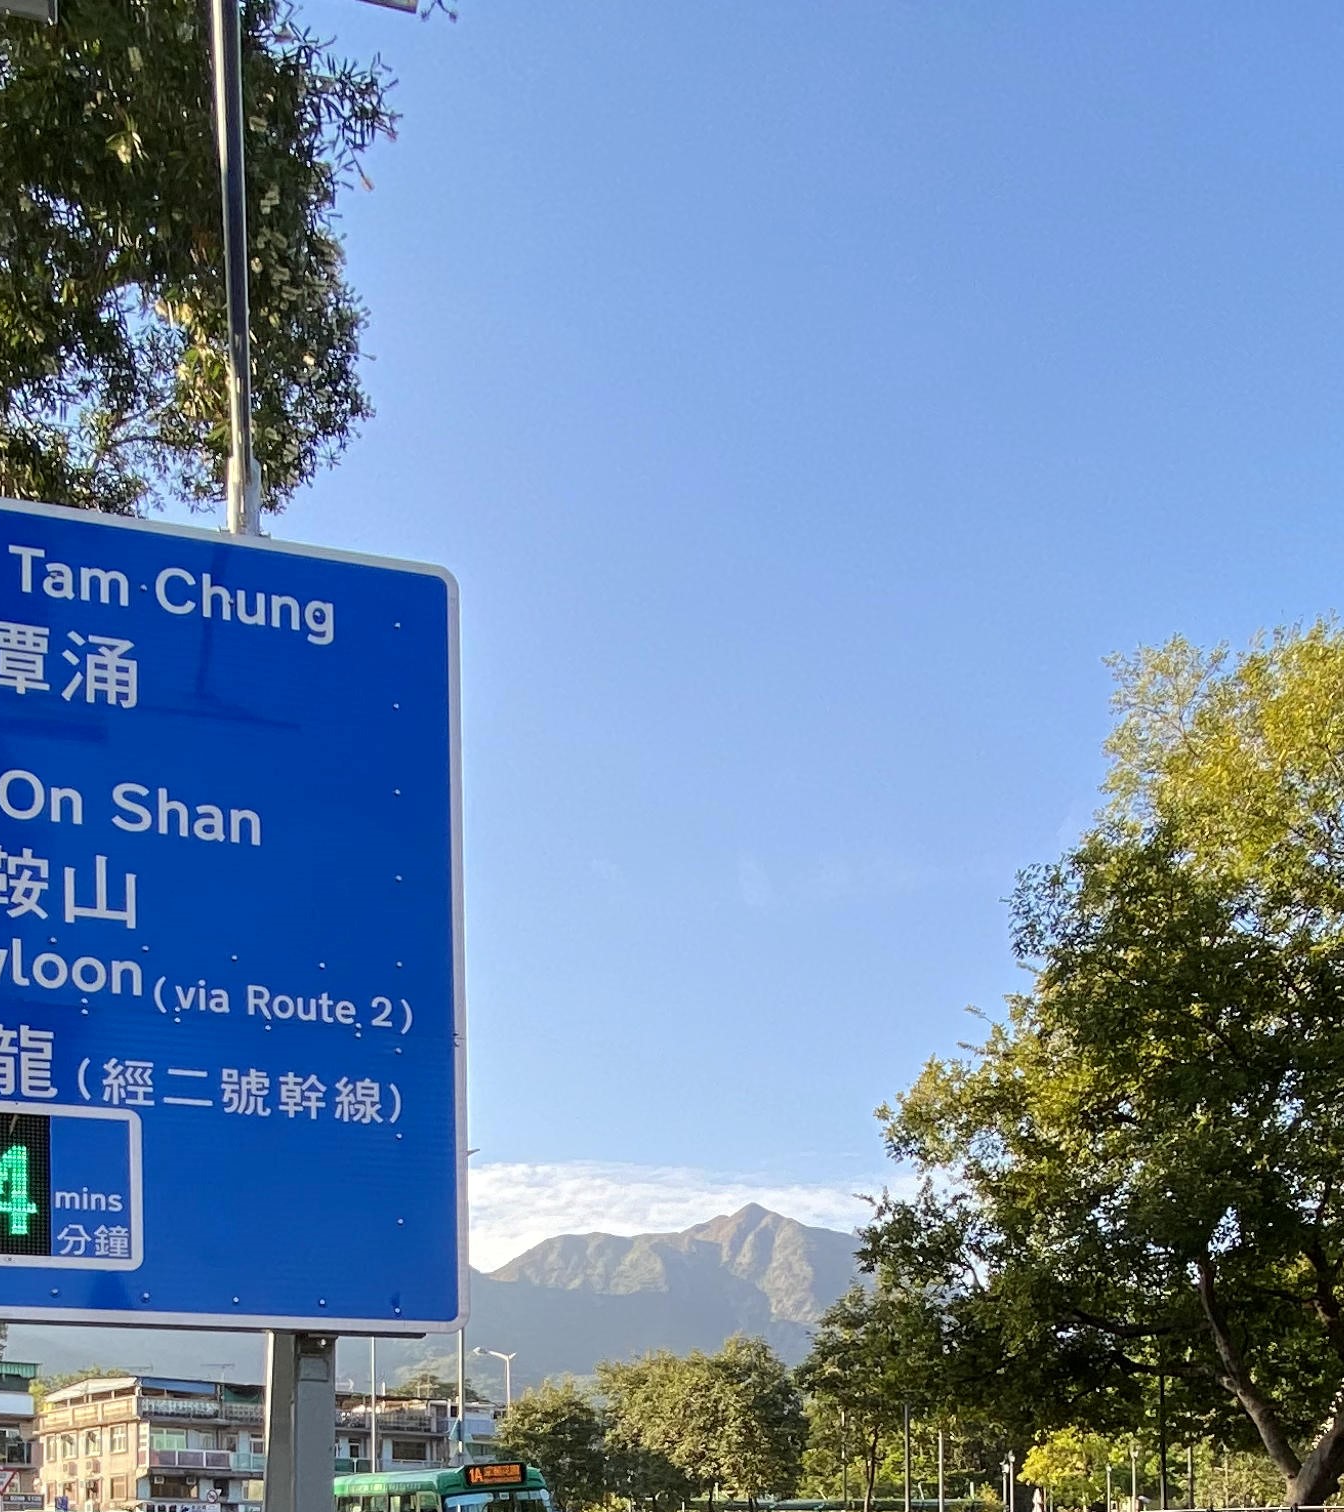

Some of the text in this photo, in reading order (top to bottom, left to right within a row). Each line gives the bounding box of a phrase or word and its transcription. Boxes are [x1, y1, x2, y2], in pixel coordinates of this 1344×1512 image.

[8, 544, 129, 607] Tam
[155, 567, 335, 645] Chung
[112, 782, 262, 847] Shan
[153, 976, 230, 1014] (via
[247, 985, 356, 1026] Route
[369, 997, 413, 1034] 2)
[55, 1187, 123, 1214] mins
[56, 1225, 131, 1259] 分鐘
